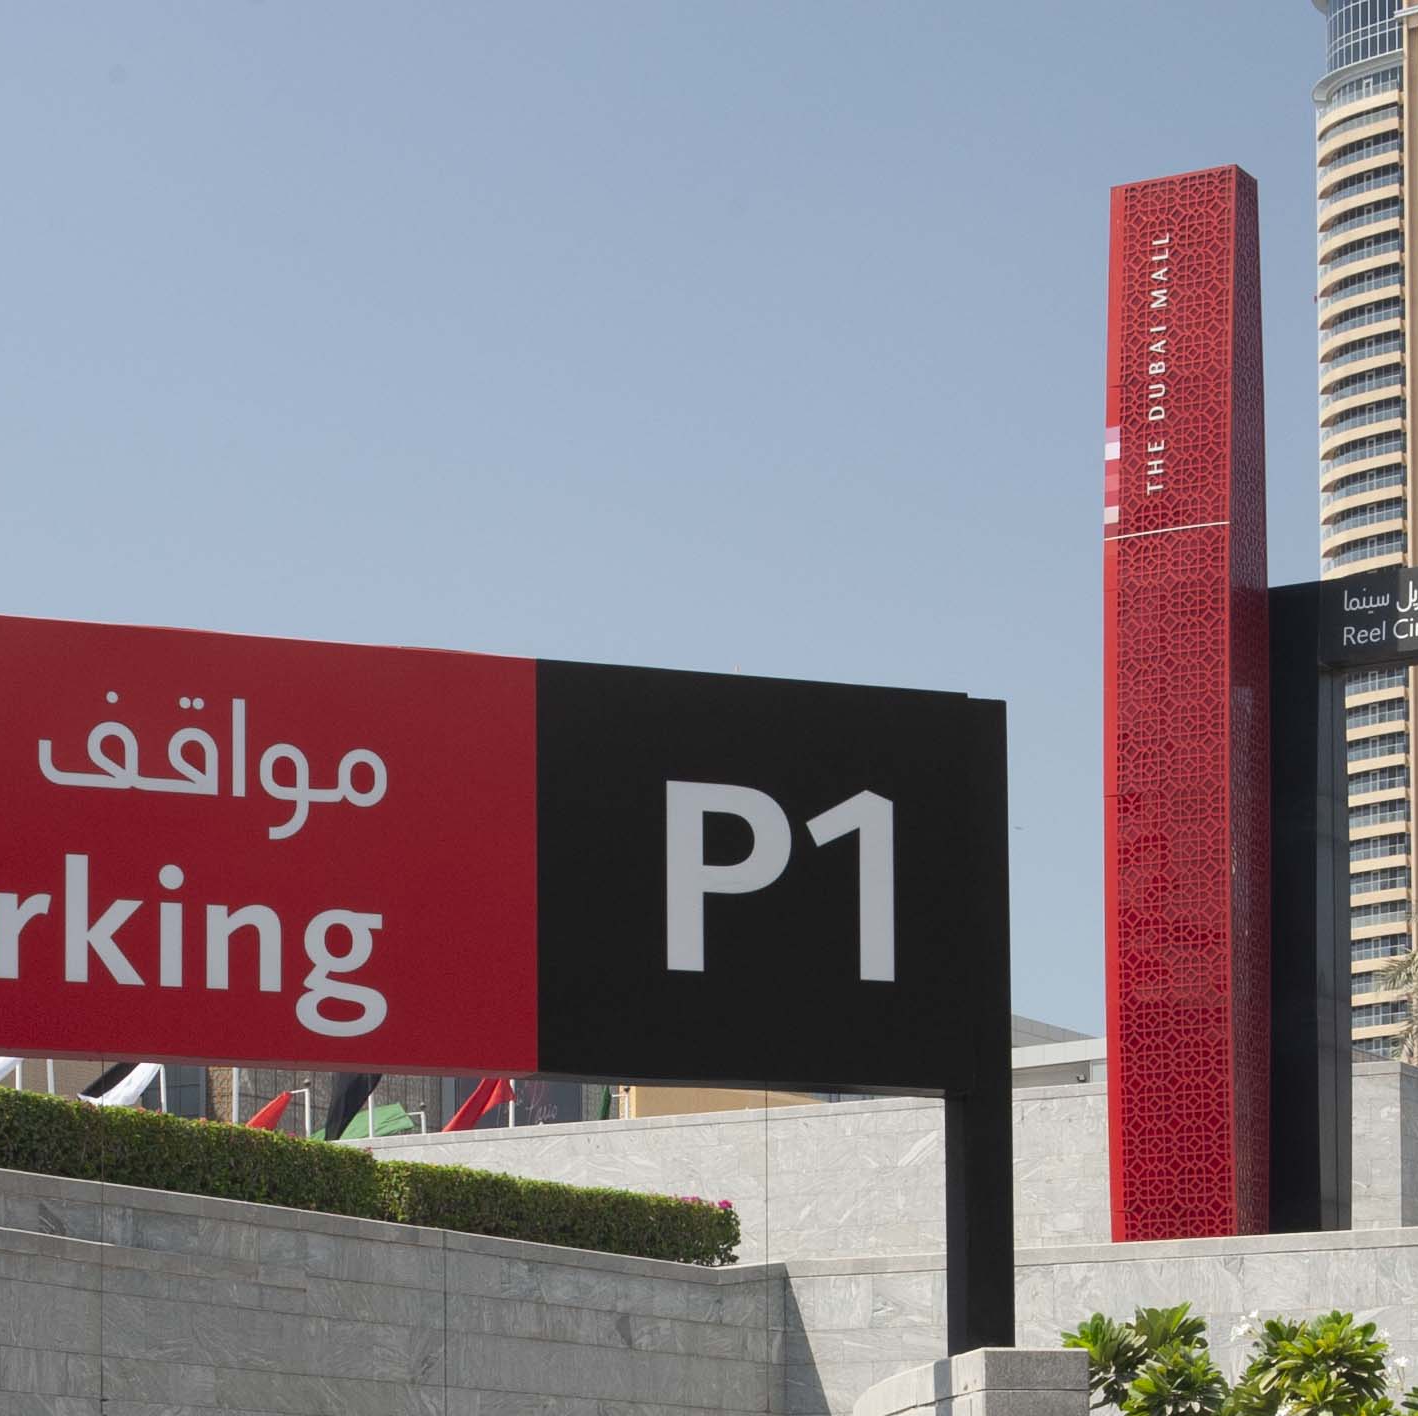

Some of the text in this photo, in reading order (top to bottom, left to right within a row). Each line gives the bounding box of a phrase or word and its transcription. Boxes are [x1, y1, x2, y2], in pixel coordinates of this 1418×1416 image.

[1147, 232, 1171, 495] THE DUBAI MALL
[1343, 588, 1390, 614] سينما
[1343, 620, 1387, 646] Reel
[39, 690, 388, 840] مواقف
[666, 780, 895, 982] P1
